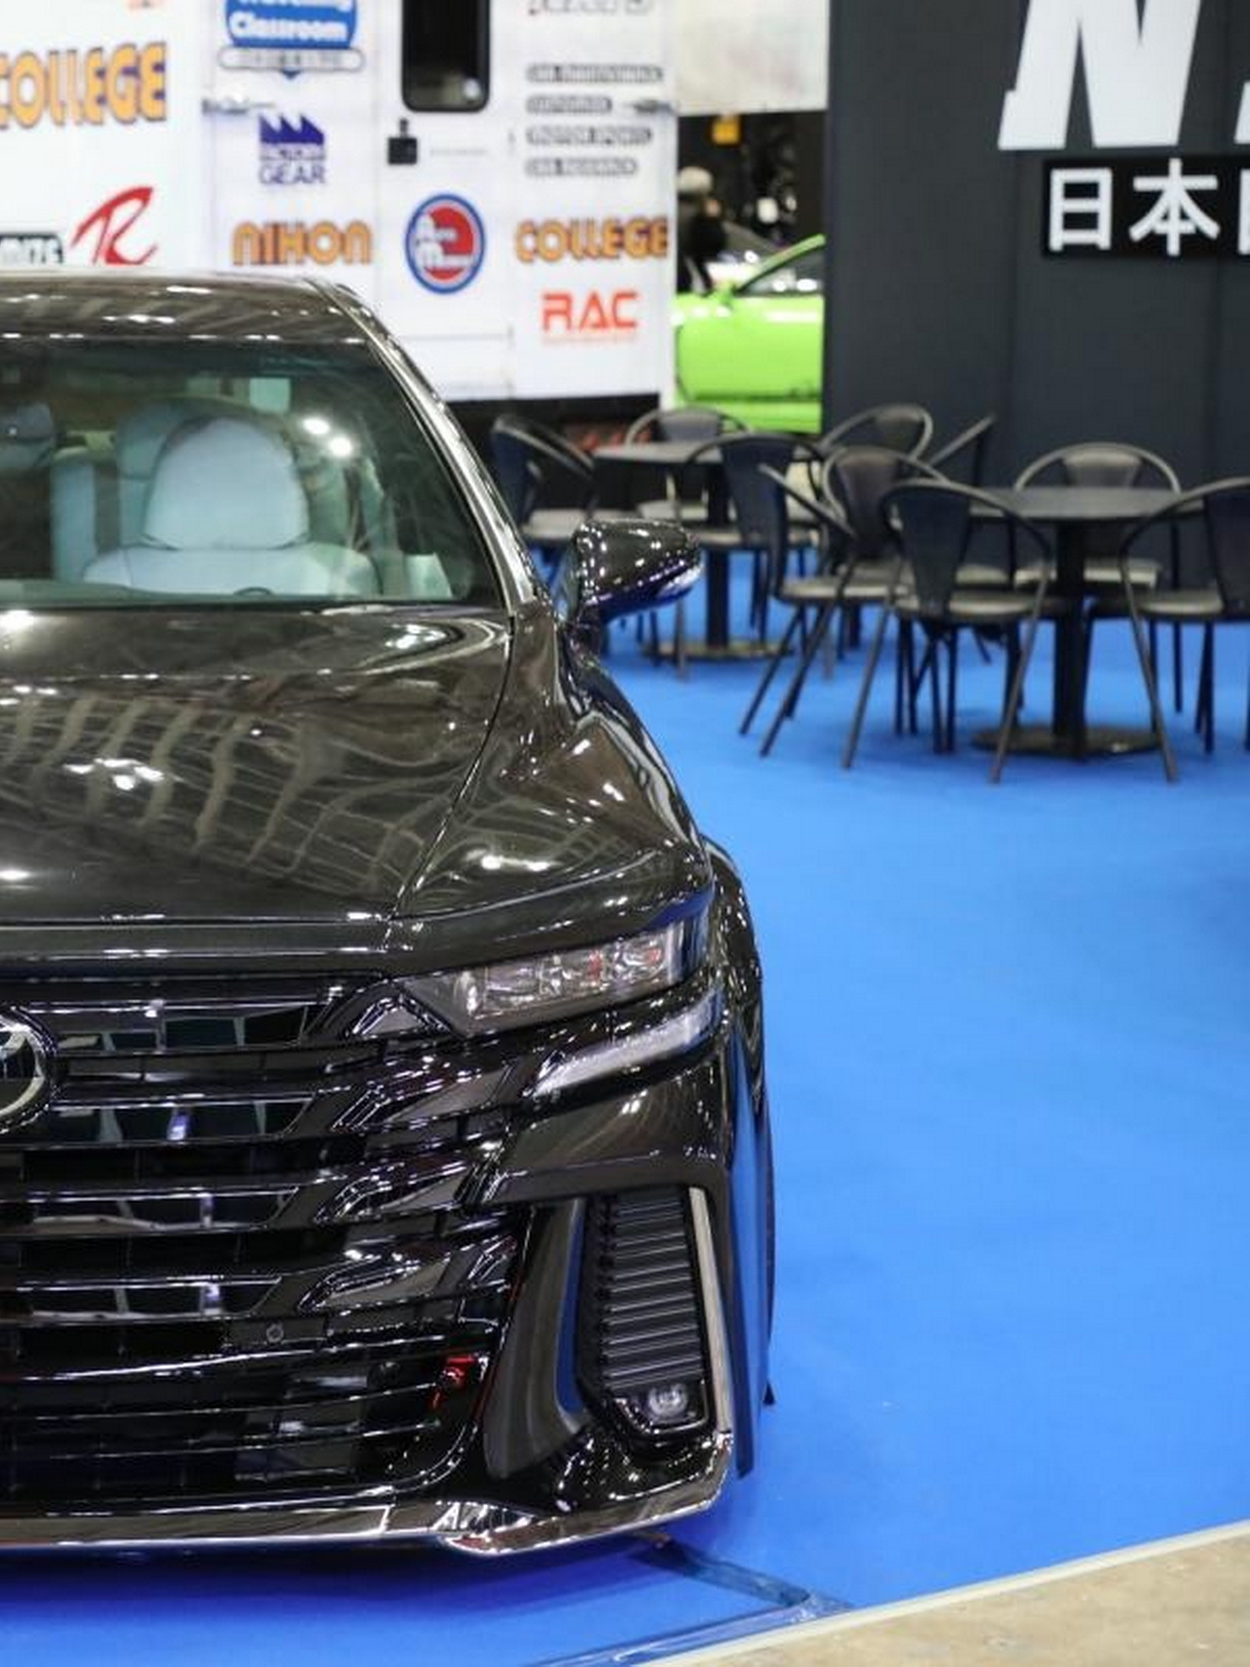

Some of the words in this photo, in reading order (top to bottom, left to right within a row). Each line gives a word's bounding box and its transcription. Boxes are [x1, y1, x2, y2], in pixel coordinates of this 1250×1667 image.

[228, 11, 347, 42] Classroom
[258, 163, 326, 185] GEAR
[1049, 158, 1250, 256] 日本
[232, 221, 374, 266] NIHON
[515, 217, 668, 263] COLLEGE
[542, 290, 638, 331] RAC
